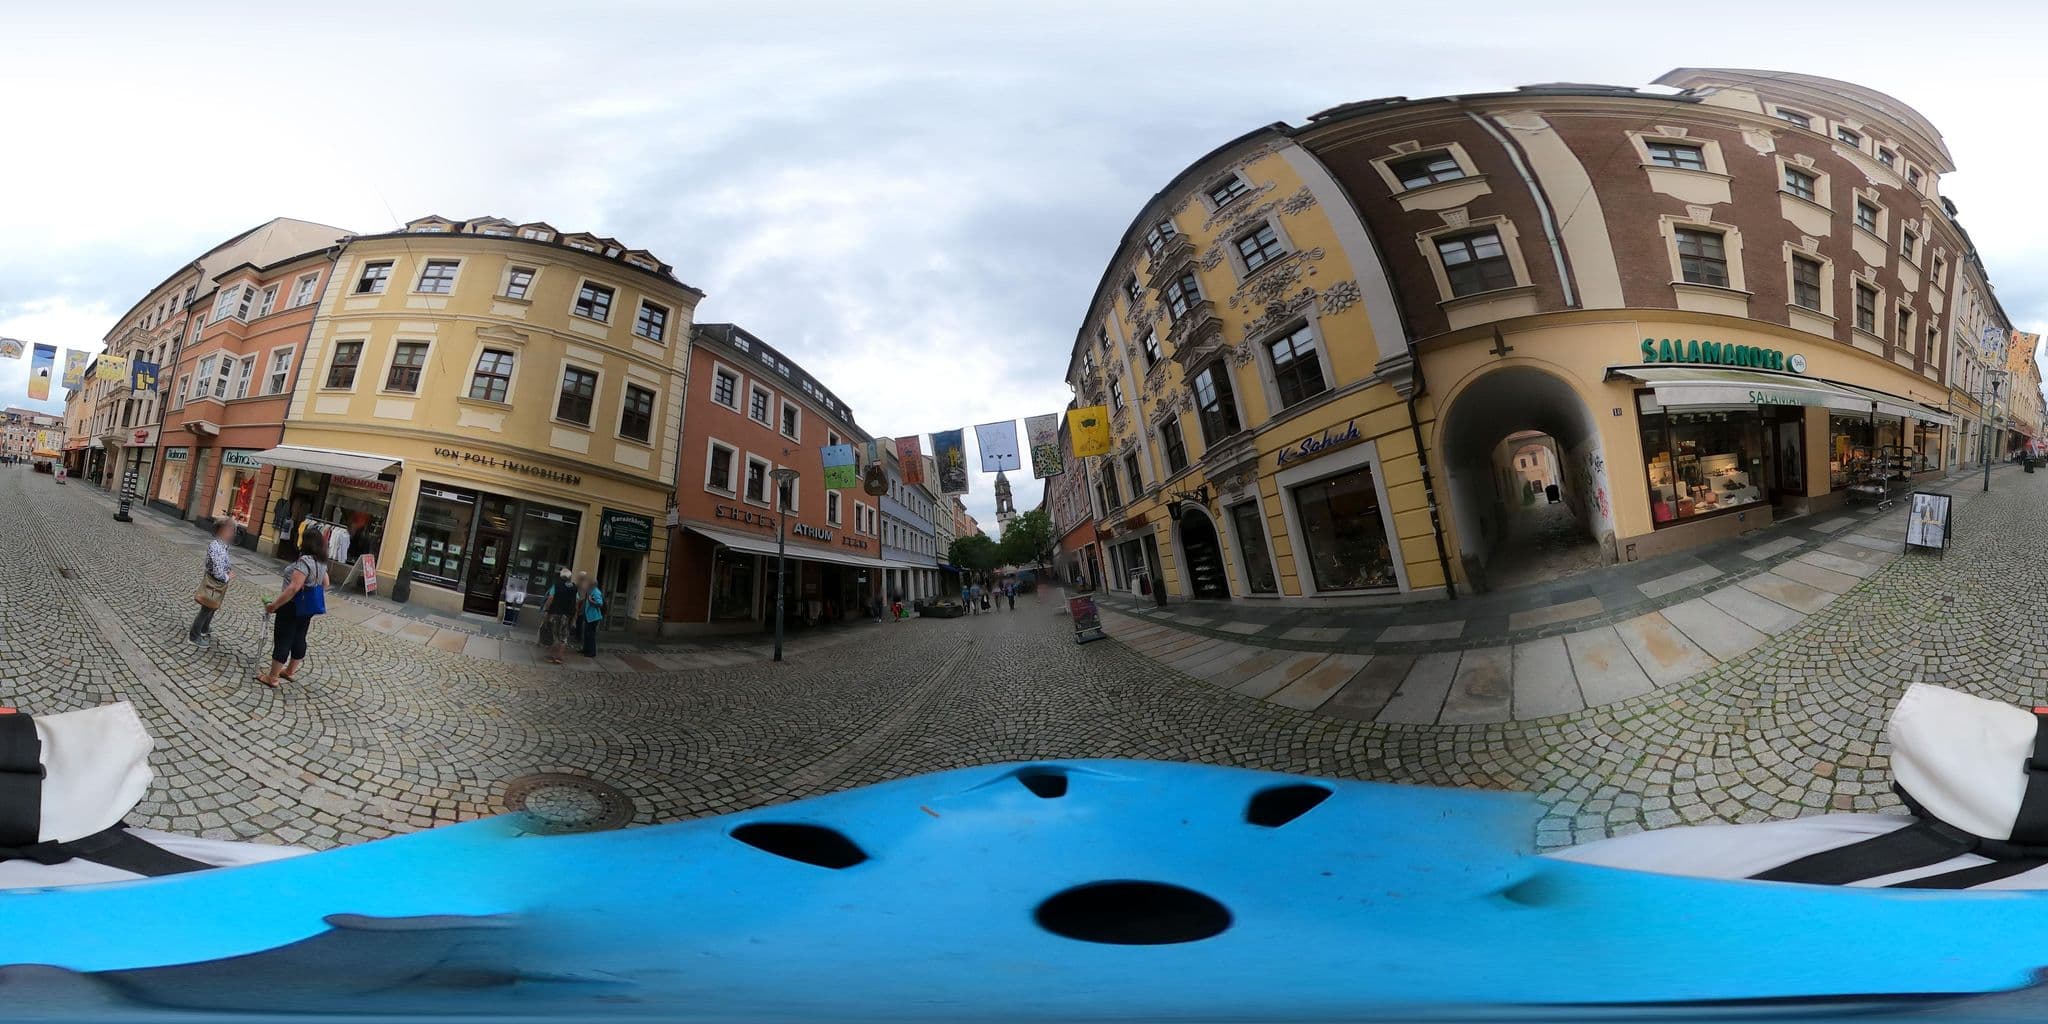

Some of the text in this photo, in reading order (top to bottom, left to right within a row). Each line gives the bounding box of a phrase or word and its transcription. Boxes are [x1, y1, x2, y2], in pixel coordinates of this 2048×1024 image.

[1642, 338, 1784, 370] SALAMANDER
[434, 447, 582, 487] VON POLL IMMOBILIEN
[715, 503, 777, 529] SHOES
[793, 522, 833, 543] ATRIUM
